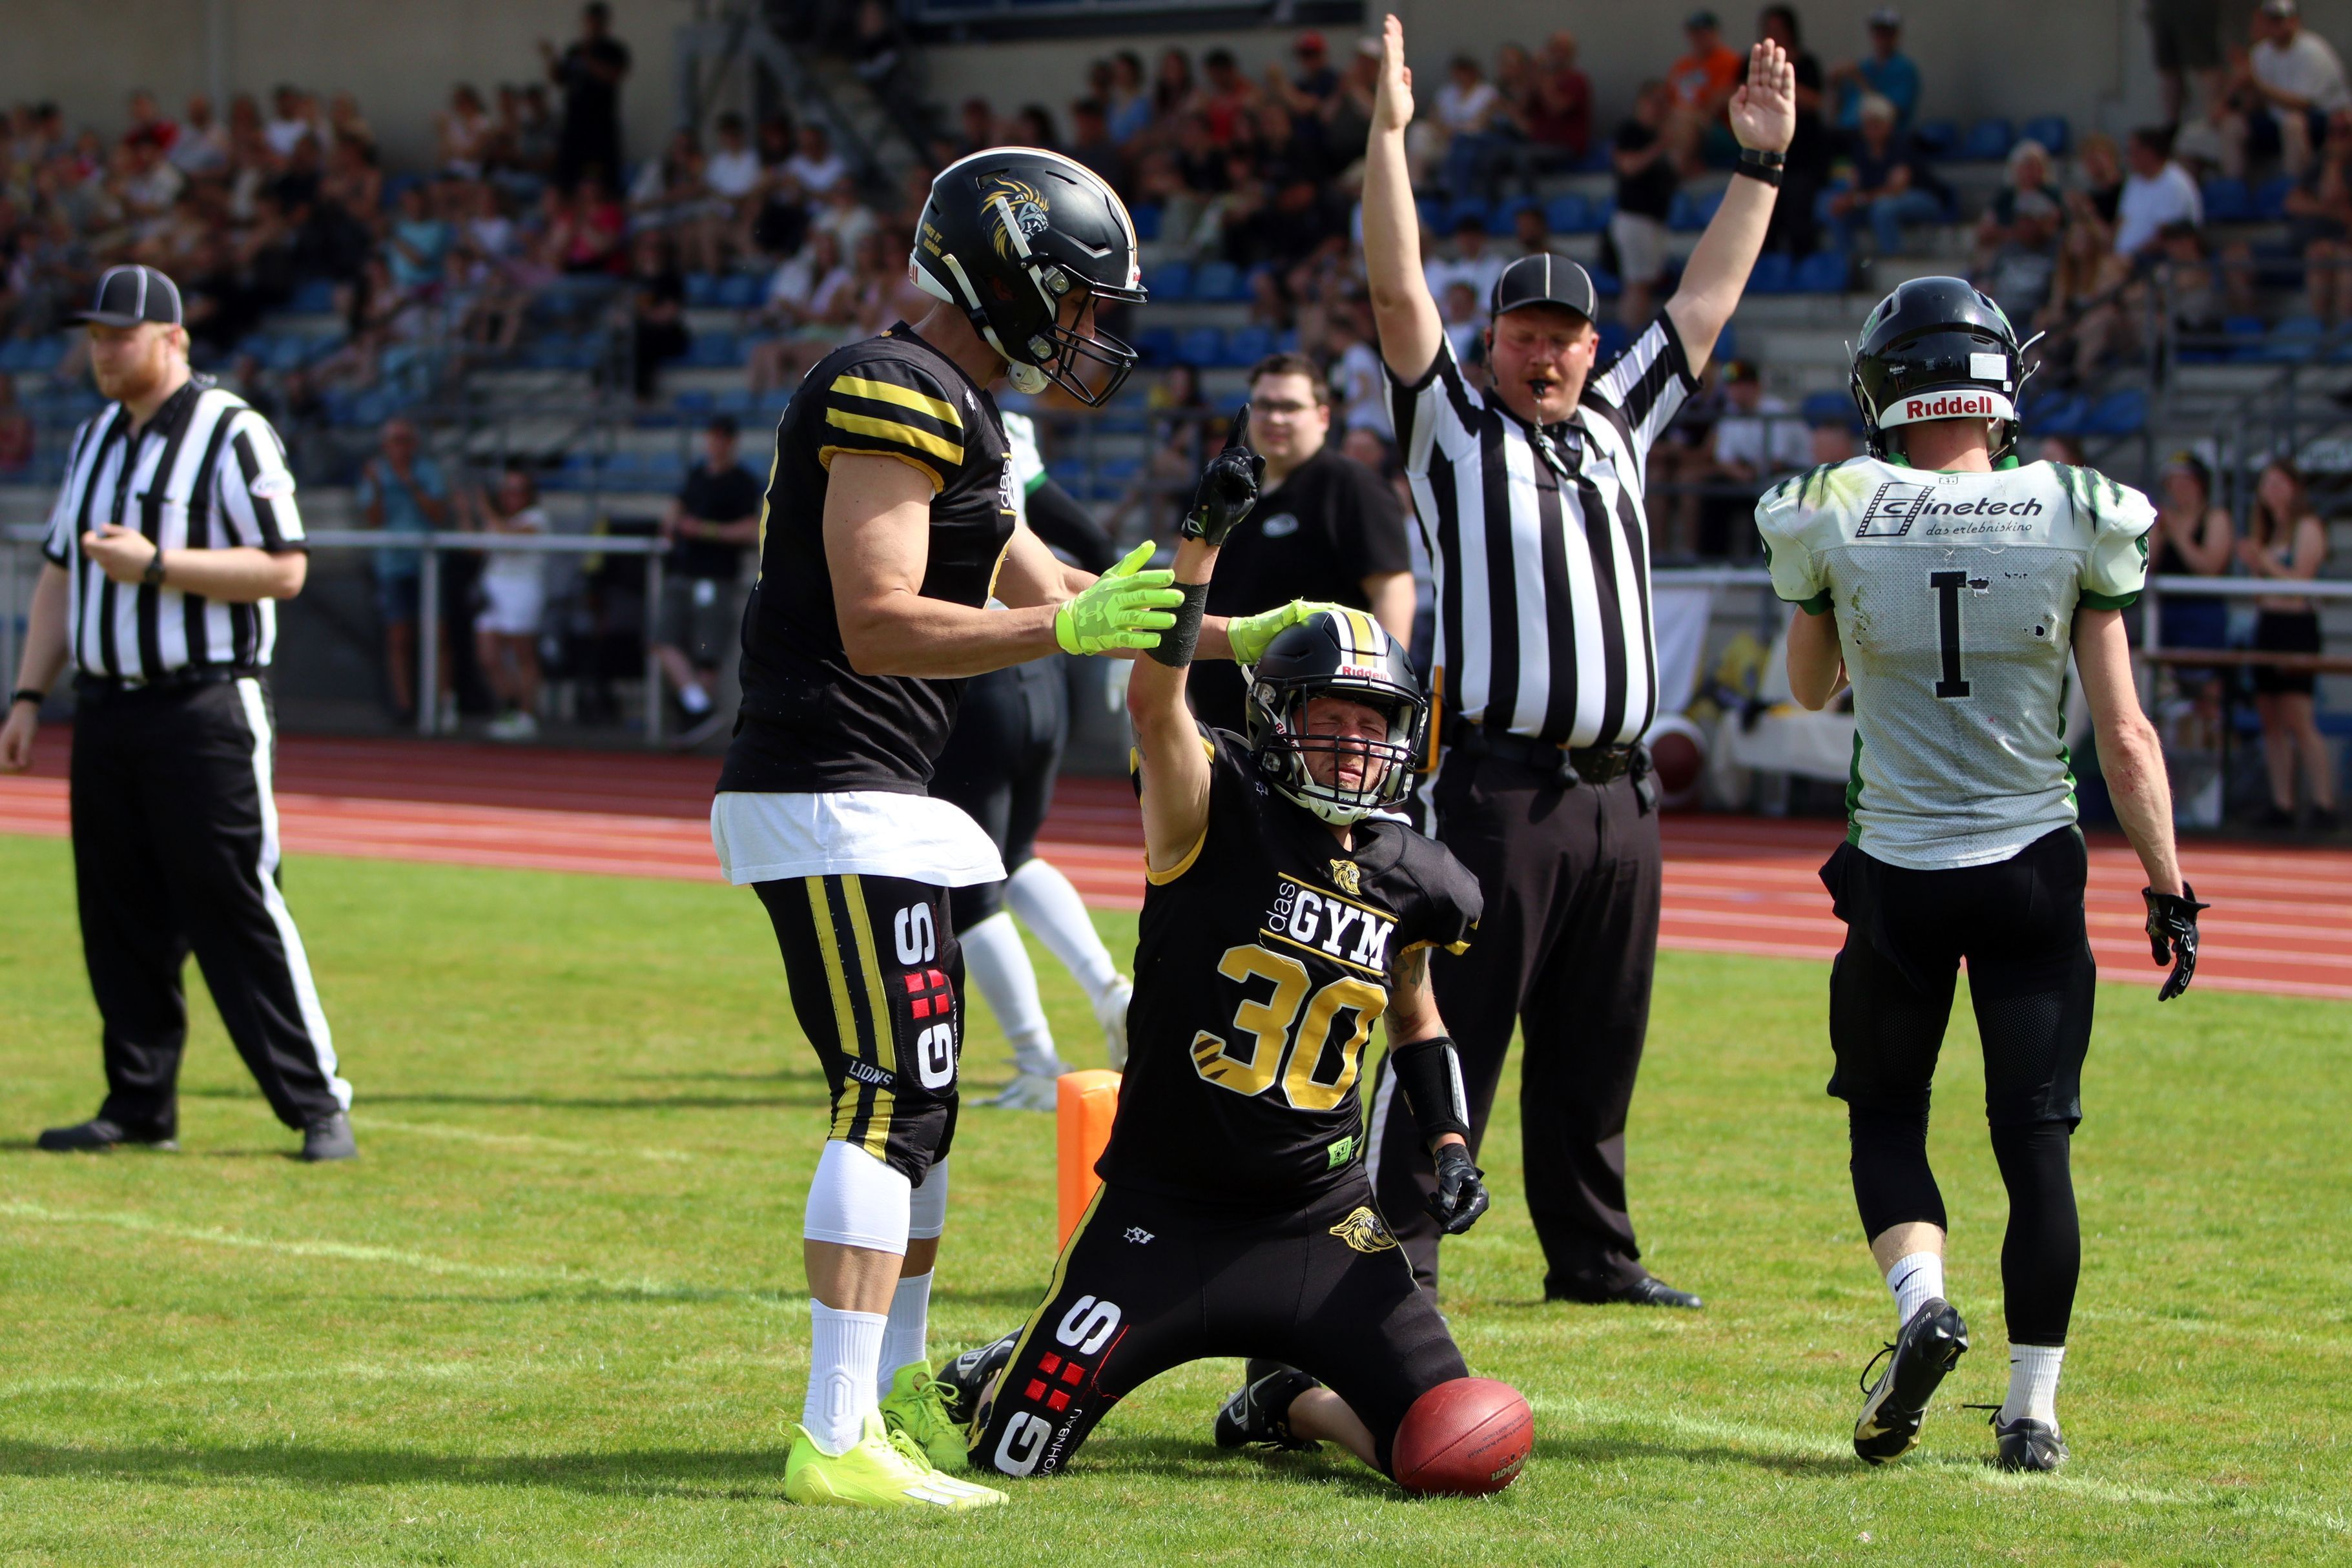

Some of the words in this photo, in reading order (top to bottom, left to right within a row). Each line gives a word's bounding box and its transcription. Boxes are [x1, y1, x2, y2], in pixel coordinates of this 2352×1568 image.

[1906, 396, 1992, 419] Riddell
[1926, 524, 1949, 536] das
[1953, 520, 2032, 534] erlebniskino
[1343, 666, 1388, 681] Riddell
[1266, 882, 1296, 933] das
[1288, 890, 1394, 971] GYM
[1190, 943, 1389, 1111] 30
[849, 1059, 894, 1087] LIONS
[1491, 1451, 1528, 1481] Wilson
